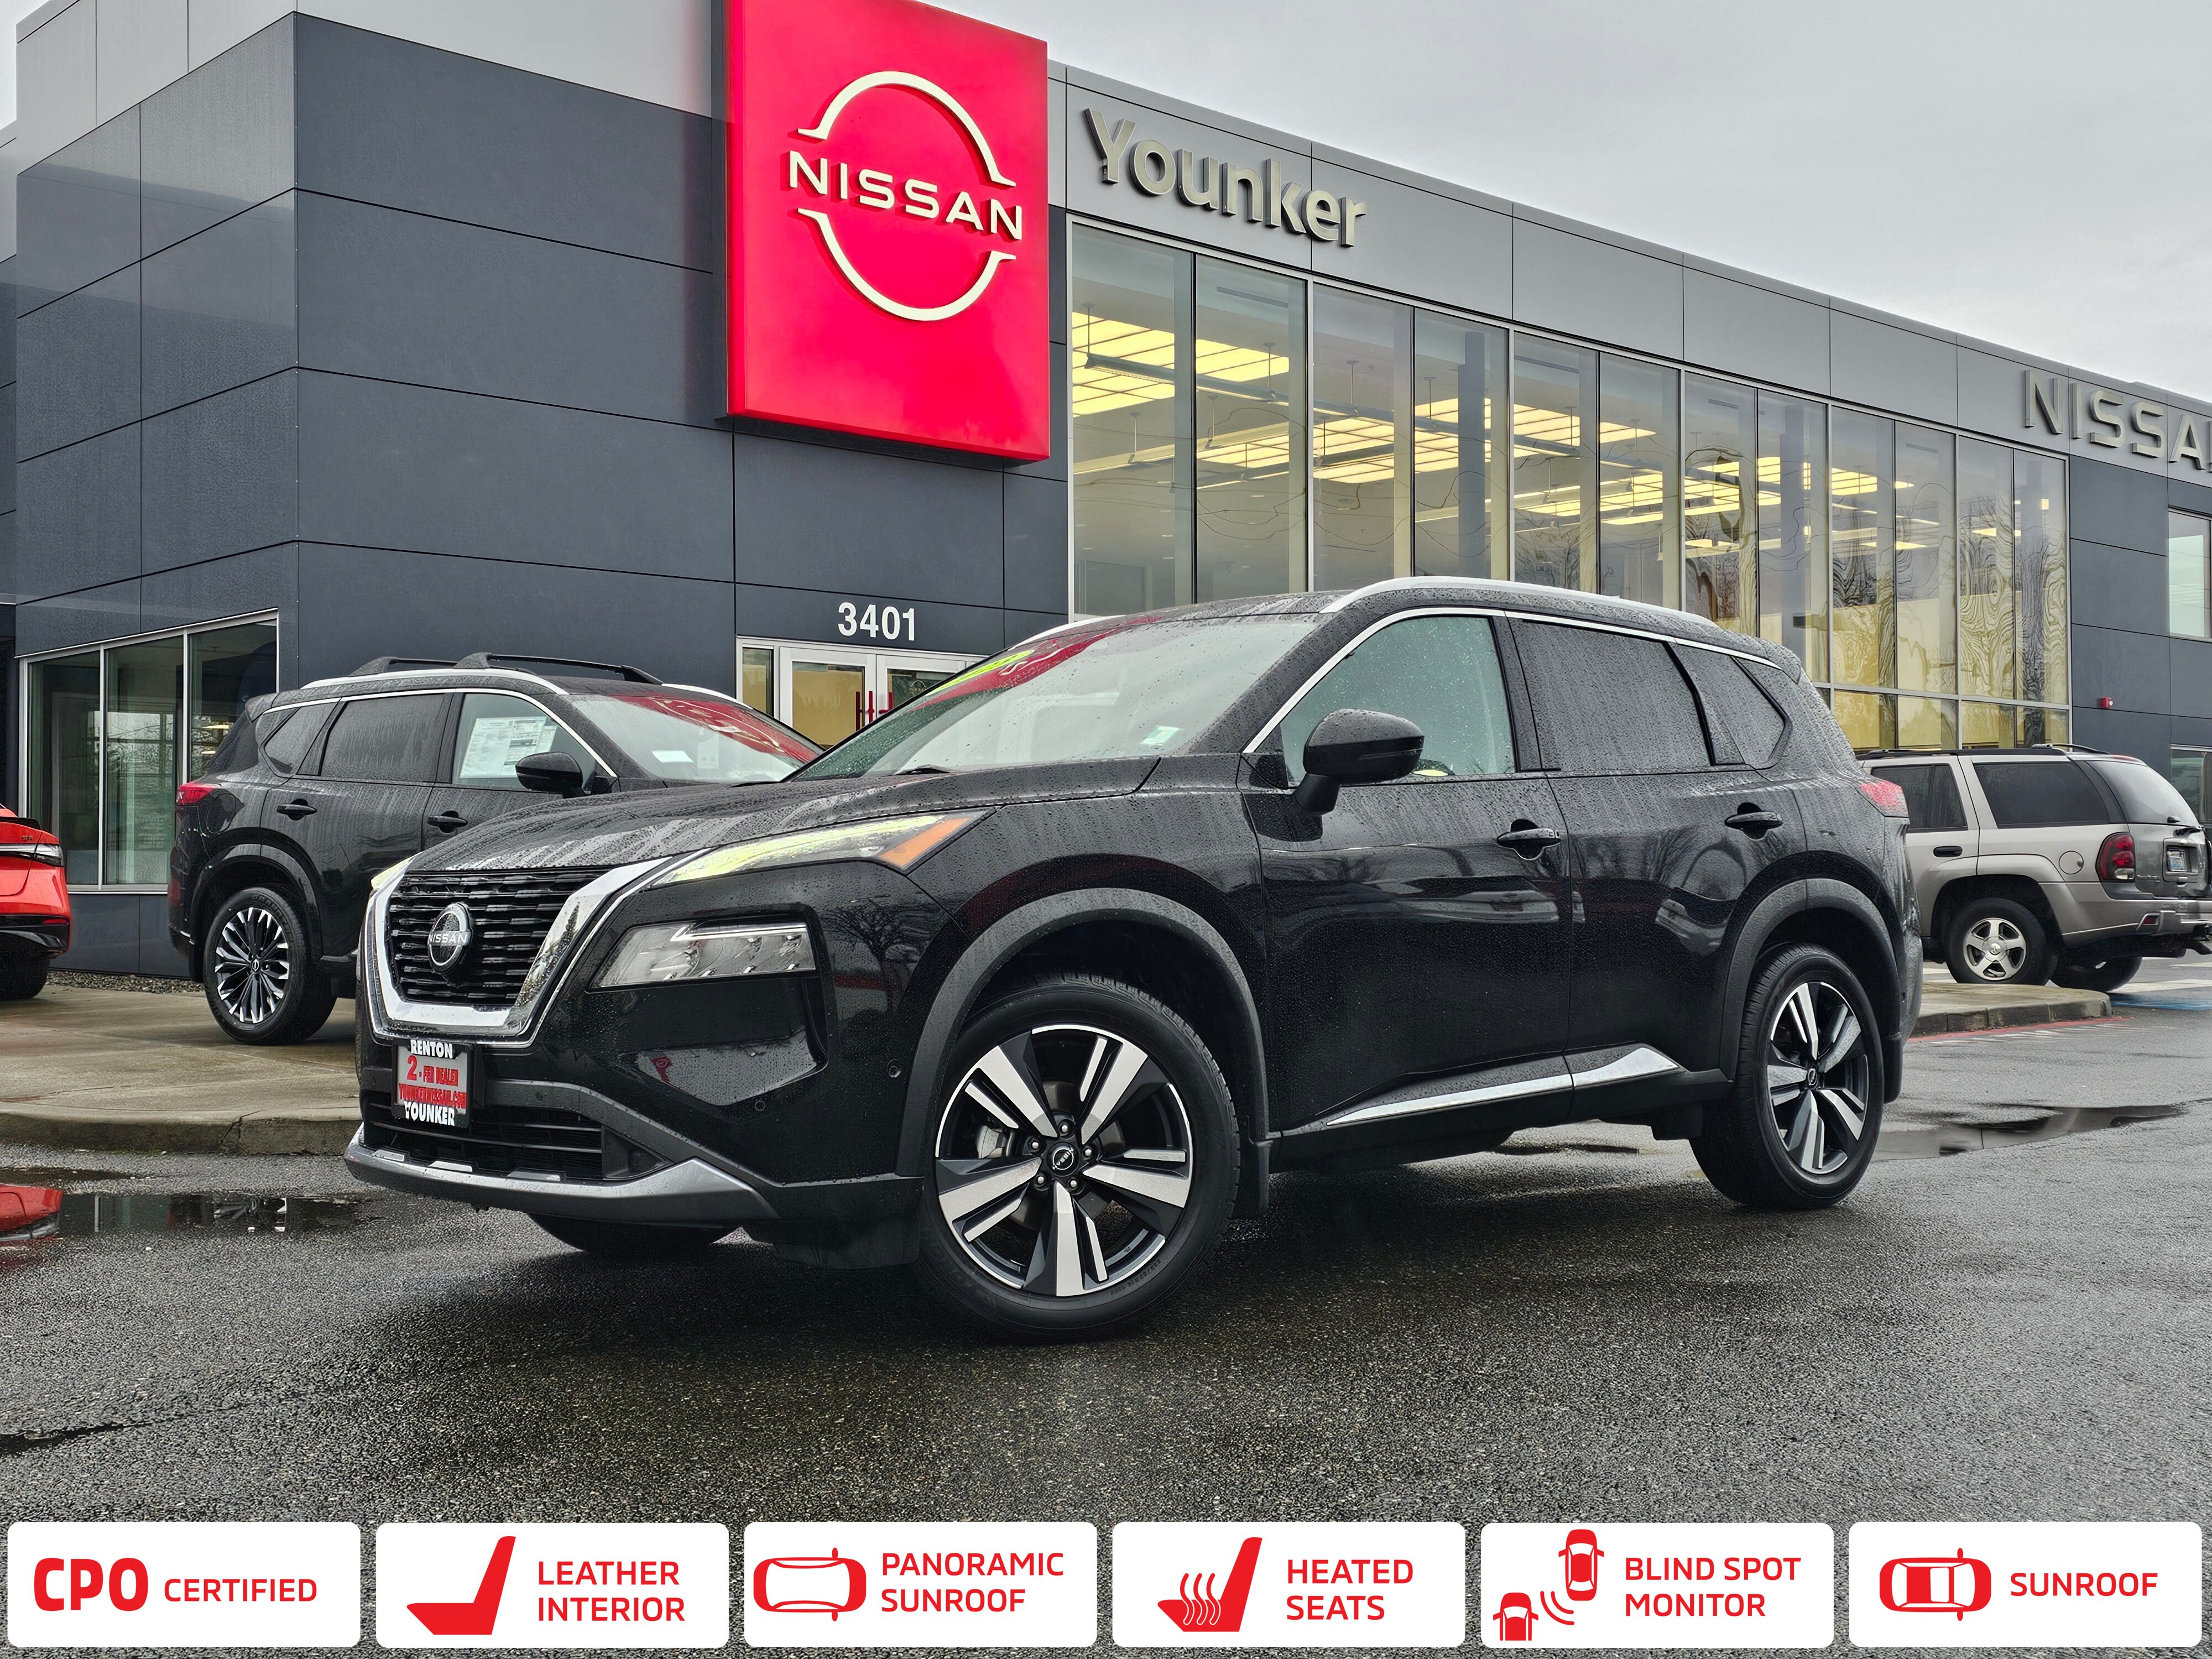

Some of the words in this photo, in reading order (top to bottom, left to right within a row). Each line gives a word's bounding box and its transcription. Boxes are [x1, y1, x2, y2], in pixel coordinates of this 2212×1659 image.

[1084, 108, 1366, 247] Younker
[789, 150, 1022, 241] NISSAN
[2024, 369, 2212, 473] NISSA
[837, 602, 915, 641] 3401
[429, 933, 467, 943] NISSAN
[410, 1039, 453, 1059] RENTON
[406, 1055, 418, 1081] 2
[403, 1100, 455, 1126] YOUNKER
